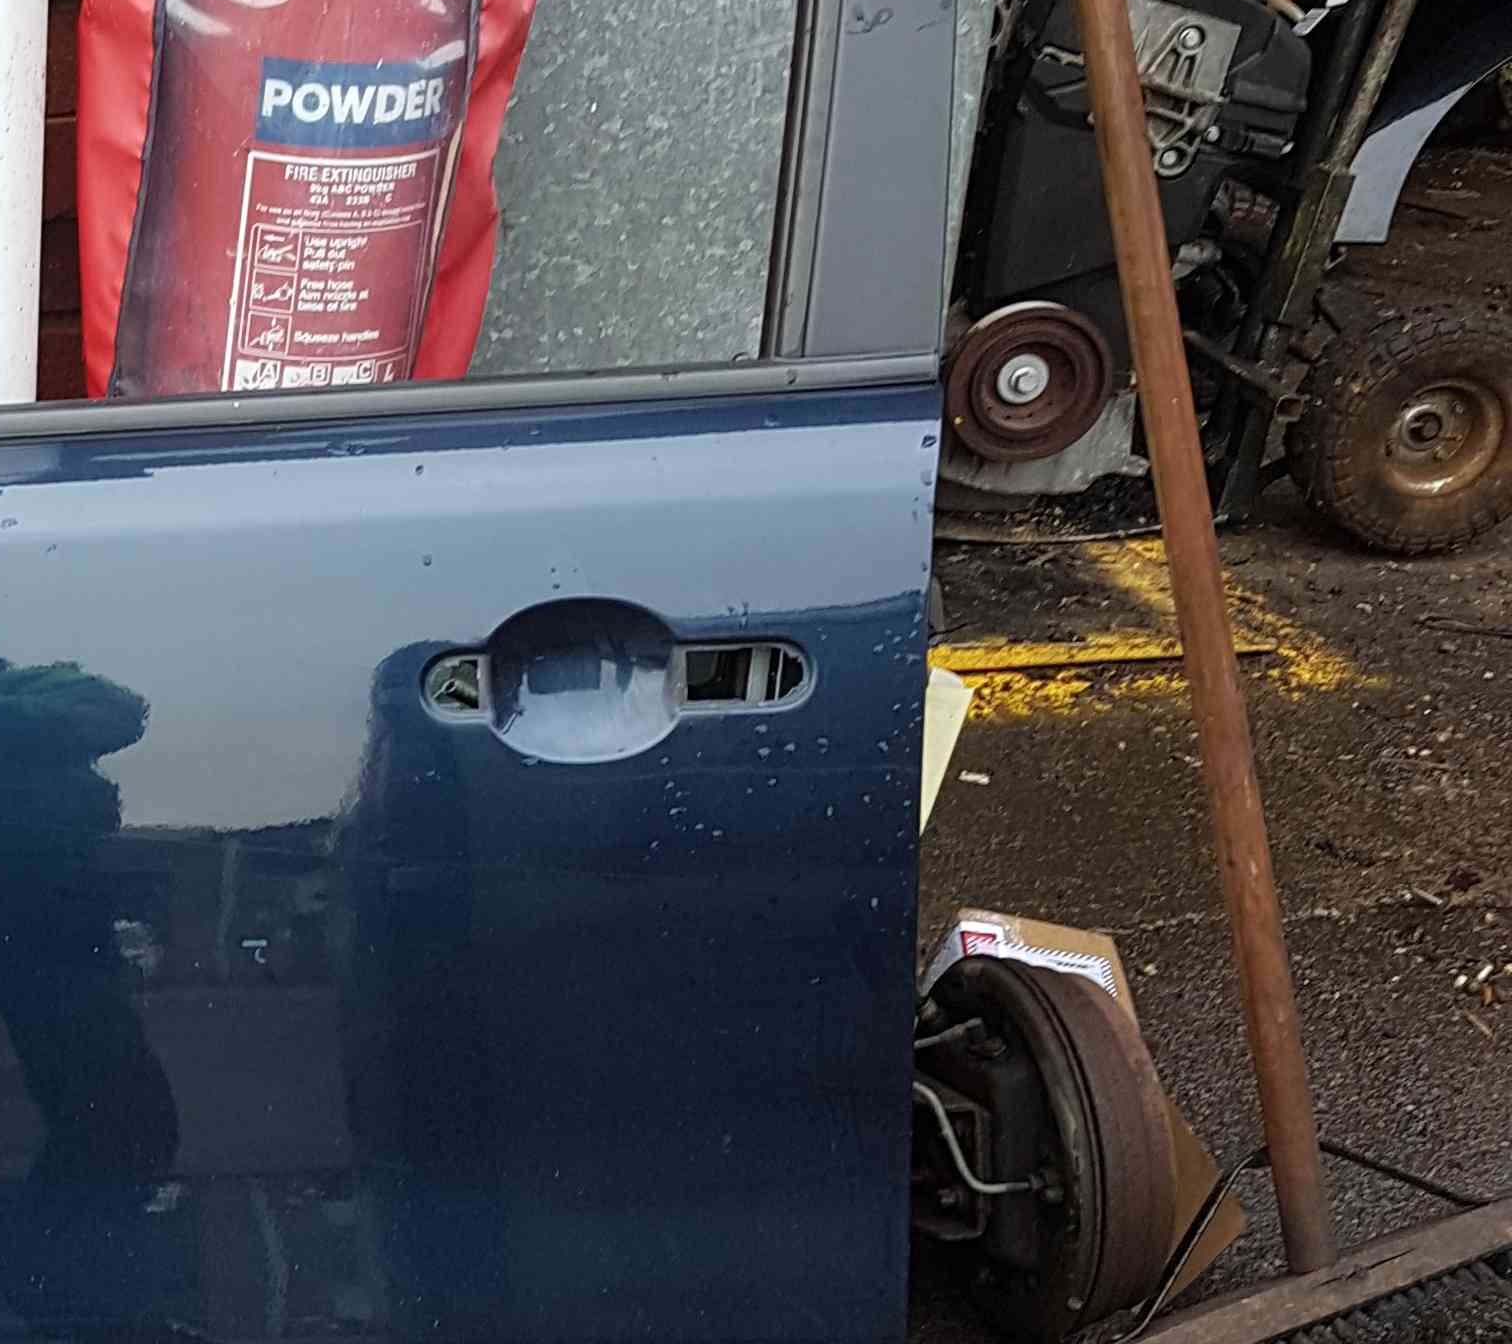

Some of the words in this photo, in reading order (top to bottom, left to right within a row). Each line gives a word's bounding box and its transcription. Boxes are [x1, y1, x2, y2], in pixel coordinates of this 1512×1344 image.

[261, 77, 445, 126] POWDER
[285, 164, 318, 181] FIRE
[321, 162, 418, 183] EXTINGUISHER
